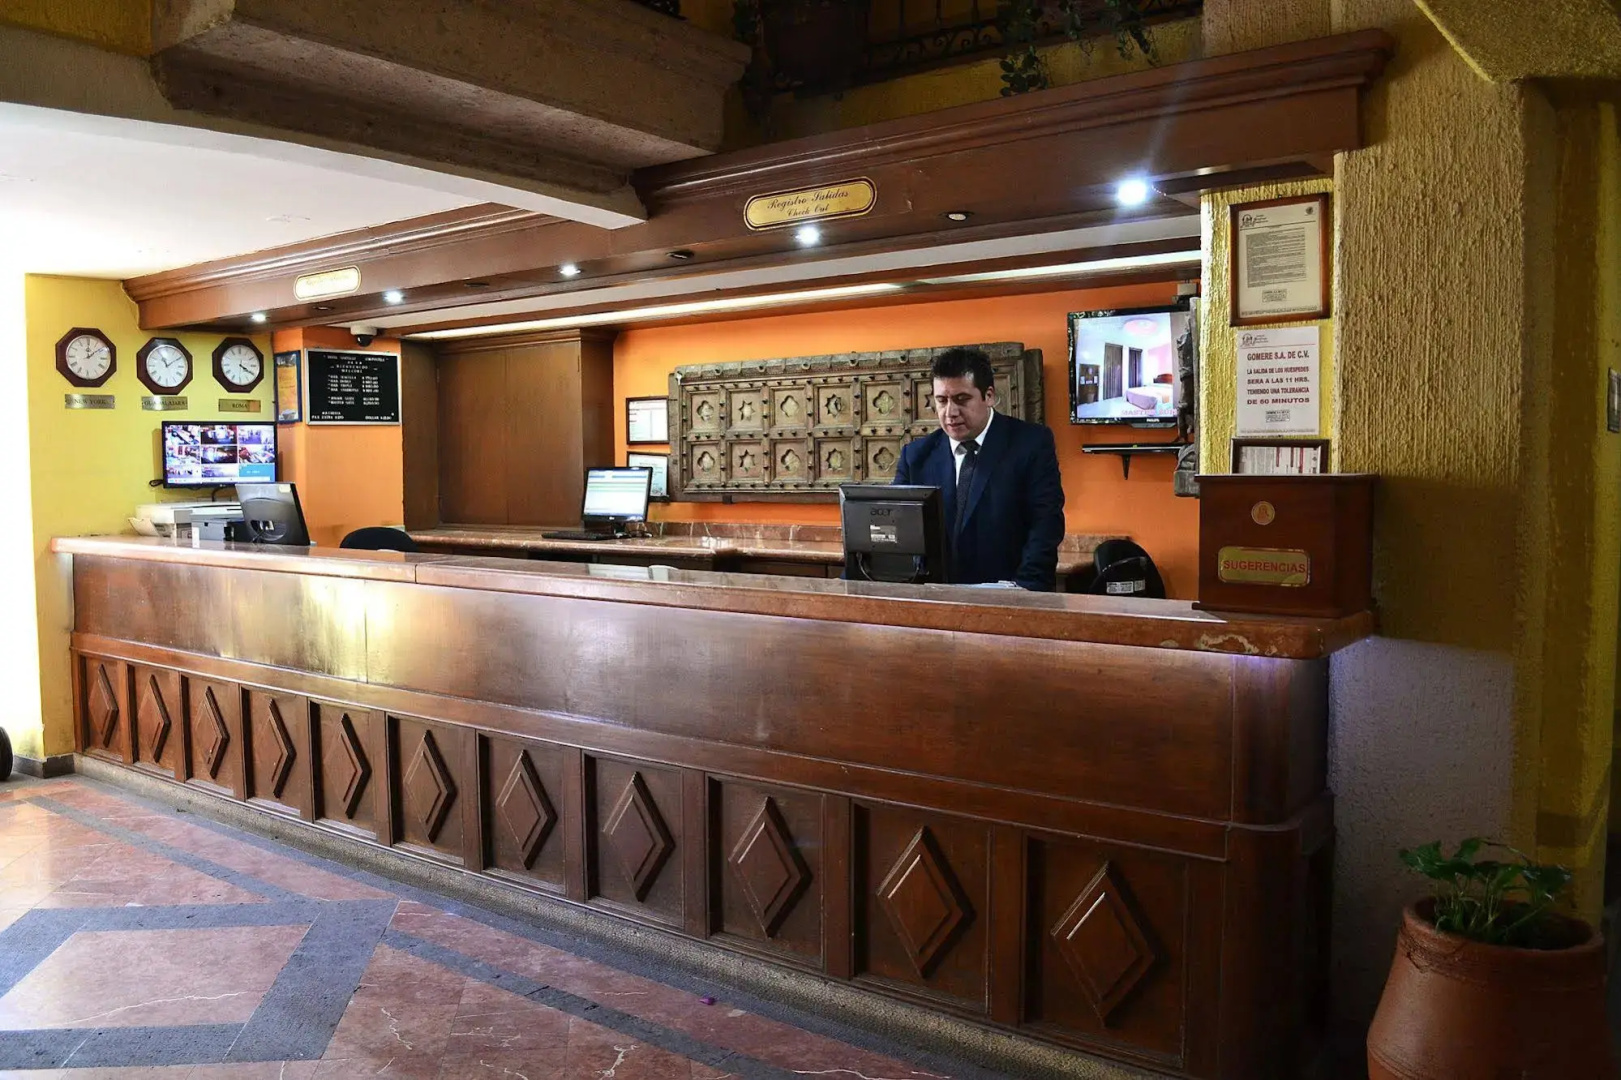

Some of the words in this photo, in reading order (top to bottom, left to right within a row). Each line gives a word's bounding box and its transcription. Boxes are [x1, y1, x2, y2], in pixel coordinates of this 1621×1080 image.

[767, 196, 807, 211] Registro
[811, 188, 849, 202] Salidas
[787, 207, 810, 217] Check
[814, 203, 830, 213] Out
[1247, 352, 1273, 361] GOMERE
[1288, 351, 1296, 359] DE
[1298, 350, 1310, 358] C.V.
[870, 508, 891, 516] acer
[1223, 560, 1306, 573] SUGERENCIAS
